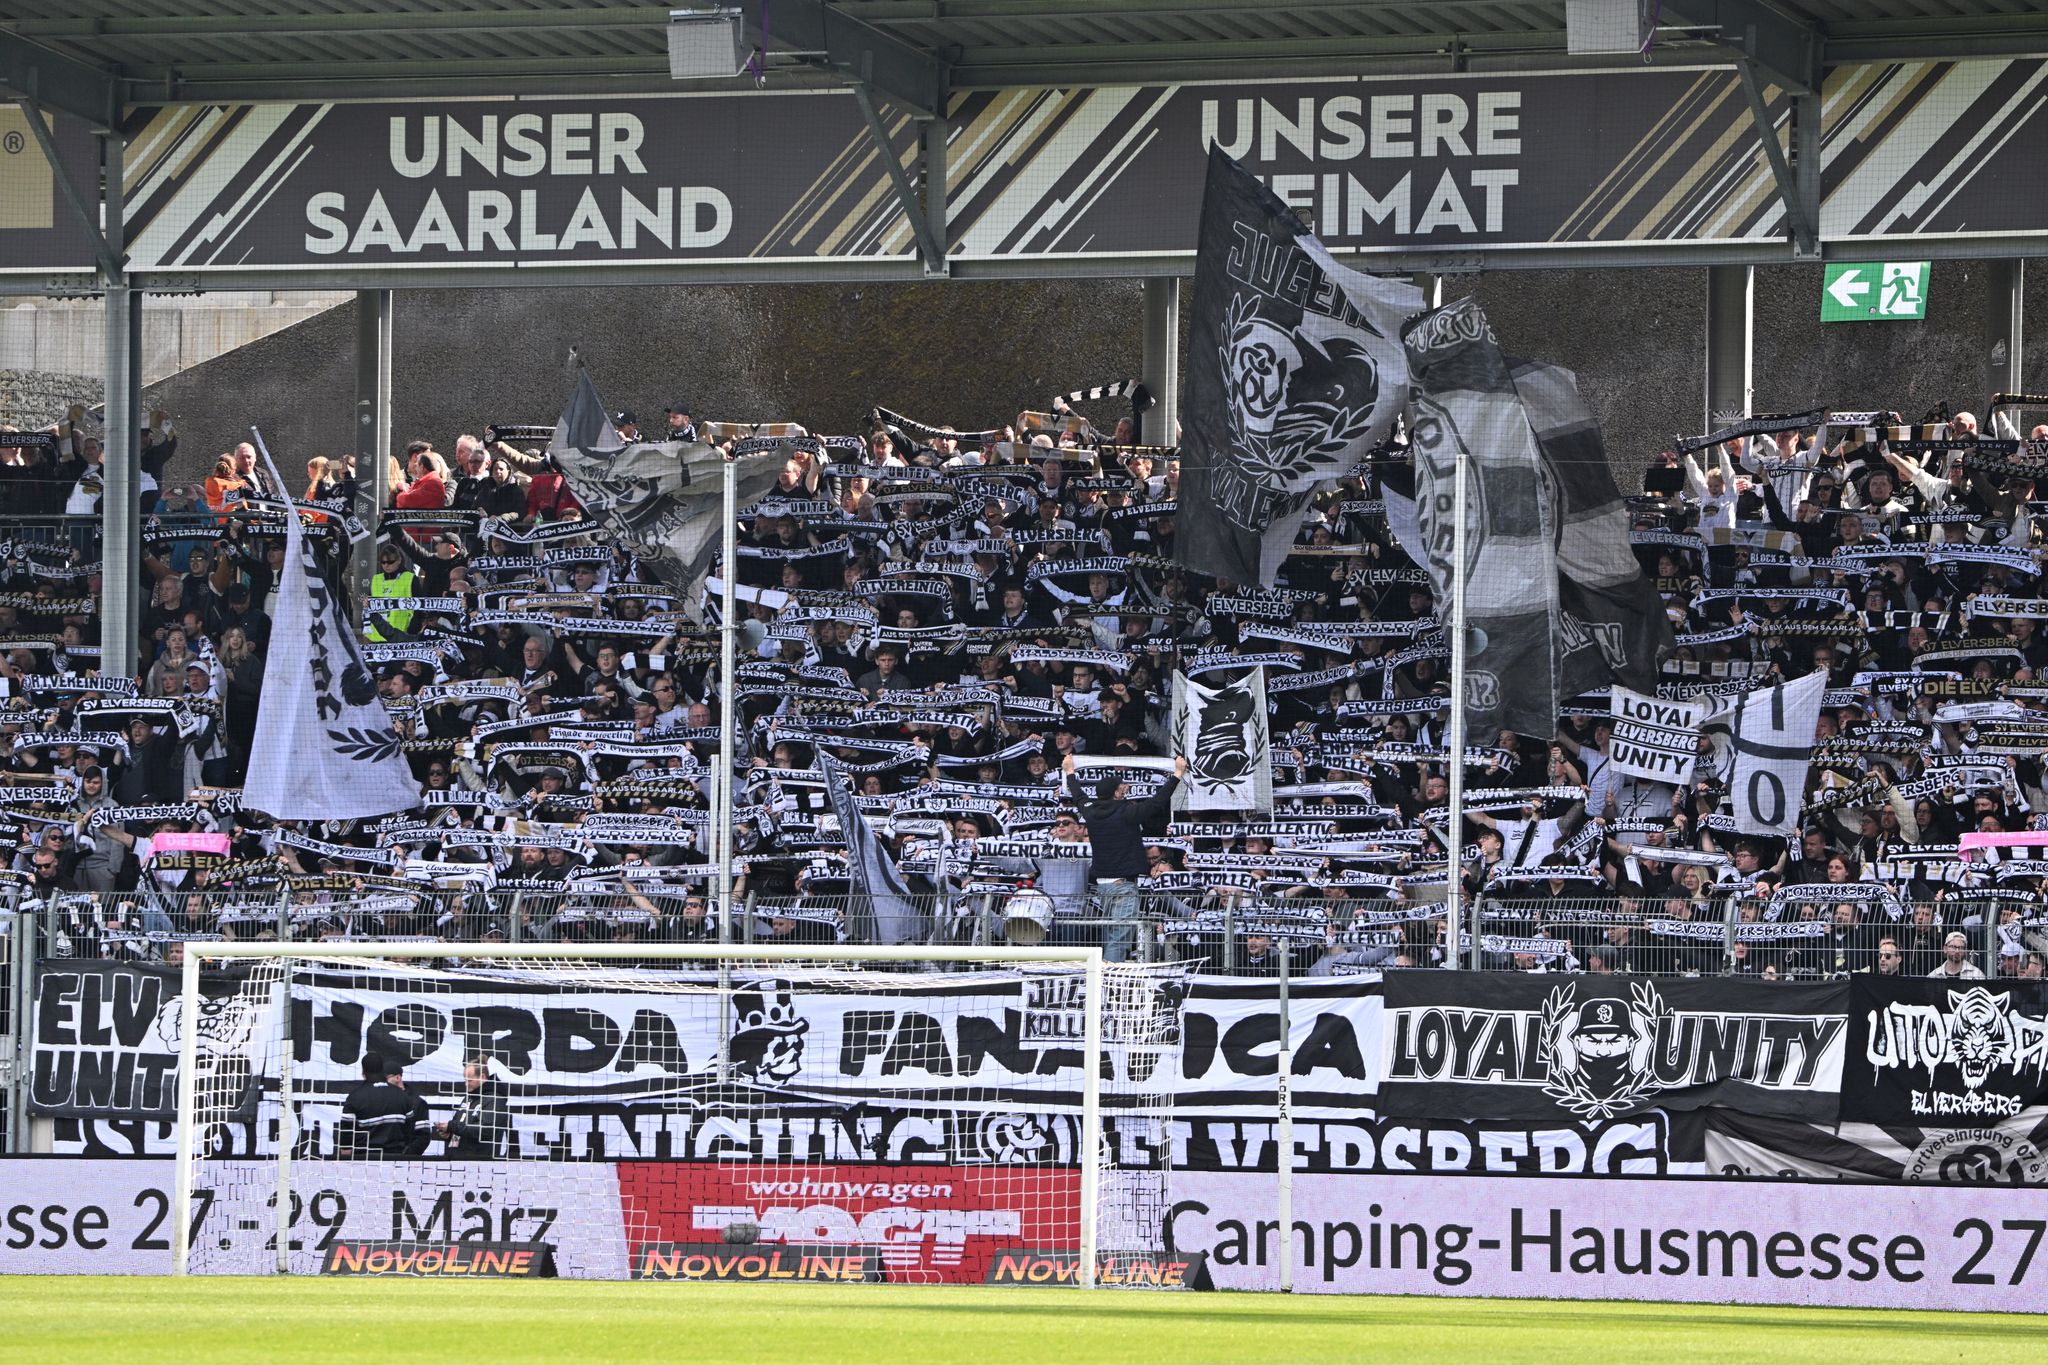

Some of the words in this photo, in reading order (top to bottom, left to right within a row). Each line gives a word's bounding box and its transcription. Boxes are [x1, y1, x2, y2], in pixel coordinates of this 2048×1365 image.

[1201, 92, 1521, 163] UNSERE
[389, 112, 647, 178] UNSER
[1253, 167, 1519, 236] EIMAT
[304, 185, 732, 257] SAARLAND
[888, 467, 931, 479] UNITED
[790, 502, 834, 514] UNITED
[1111, 511, 1124, 520] SV
[1909, 514, 1983, 524] ELVERSBERG
[144, 531, 156, 542] SV
[159, 528, 224, 539] ELVERSBERG
[247, 525, 261, 534] SV
[539, 529, 557, 538] DEM
[558, 520, 598, 534] SAARLAND
[898, 521, 914, 536] SV
[1013, 528, 1100, 542] ELVERSBERG
[1750, 553, 1776, 563] BLOCK
[1088, 604, 1170, 615] SAARLAND
[1212, 600, 1292, 616] ELVERSBERG
[1974, 600, 2048, 614] ELVERSB
[882, 630, 898, 638] AUS
[899, 631, 917, 639] DEM
[1148, 637, 1163, 645] SV
[1197, 644, 1212, 656] SV
[1212, 644, 1227, 654] 07
[1941, 637, 2021, 651] ELVERSBERG
[1657, 688, 1676, 701] SV
[1923, 681, 1956, 695] DIE
[84, 700, 98, 711] SV
[101, 698, 175, 709] ELVERSBERG
[1347, 696, 1441, 715] ELVERSBERG
[1613, 721, 1699, 750] ELVERSBERG
[1852, 726, 1924, 738] ELVERSBERG
[22, 732, 118, 747] ELVERSBERG
[1850, 739, 1868, 747] DEM
[1868, 740, 1922, 750] SAARLAND
[1979, 736, 1996, 745] SV
[1998, 736, 2015, 745] 07
[1613, 743, 1690, 775] UNITY
[750, 771, 765, 783] SV
[1900, 769, 1961, 797] ERSBERG
[449, 791, 473, 802] BLOCK
[475, 791, 482, 802] C
[613, 785, 628, 793] AUS
[630, 785, 648, 793] DEM
[650, 786, 695, 797] SAARLAND
[93, 810, 107, 827] SV
[112, 804, 196, 821] ELVERSBERG
[1274, 804, 1381, 817] ELVERSBERG
[363, 819, 428, 834] ELVERSBERG
[380, 816, 395, 824] SV
[1172, 823, 1233, 837] JUGEND
[1249, 822, 1332, 836] KOLLEKTIV
[166, 836, 189, 848] DIE
[978, 843, 1039, 858] JUGEND
[1887, 845, 1904, 854] SV
[160, 857, 191, 868] DIE
[581, 867, 598, 876] DEM
[626, 868, 661, 878] UTOPIA
[291, 878, 321, 890] DIE
[571, 882, 606, 893] UTOPIA
[1945, 891, 1959, 902] SV
[1961, 888, 2037, 902] ELVERSBERG
[1674, 922, 1691, 934] SV
[2022, 918, 2038, 926] DIE
[38, 973, 162, 1047] ELV
[840, 1005, 1367, 1084] FANICA
[1390, 1010, 1552, 1083] LOYAL
[1652, 1015, 1847, 1087] UNITY
[1278, 1075, 1288, 1121] FORZA
[1910, 1090, 2023, 1117] ELVERSBERG
[749, 1176, 953, 1203] wohnwagen
[0, 1203, 109, 1250] sse
[392, 1189, 558, 1246] März
[1163, 1199, 1926, 1286] Camping-Hausmesse
[331, 1245, 533, 1274] NOVOLINE
[644, 1250, 867, 1280] NOVOLINE
[994, 1255, 1190, 1285] NOVLINE
